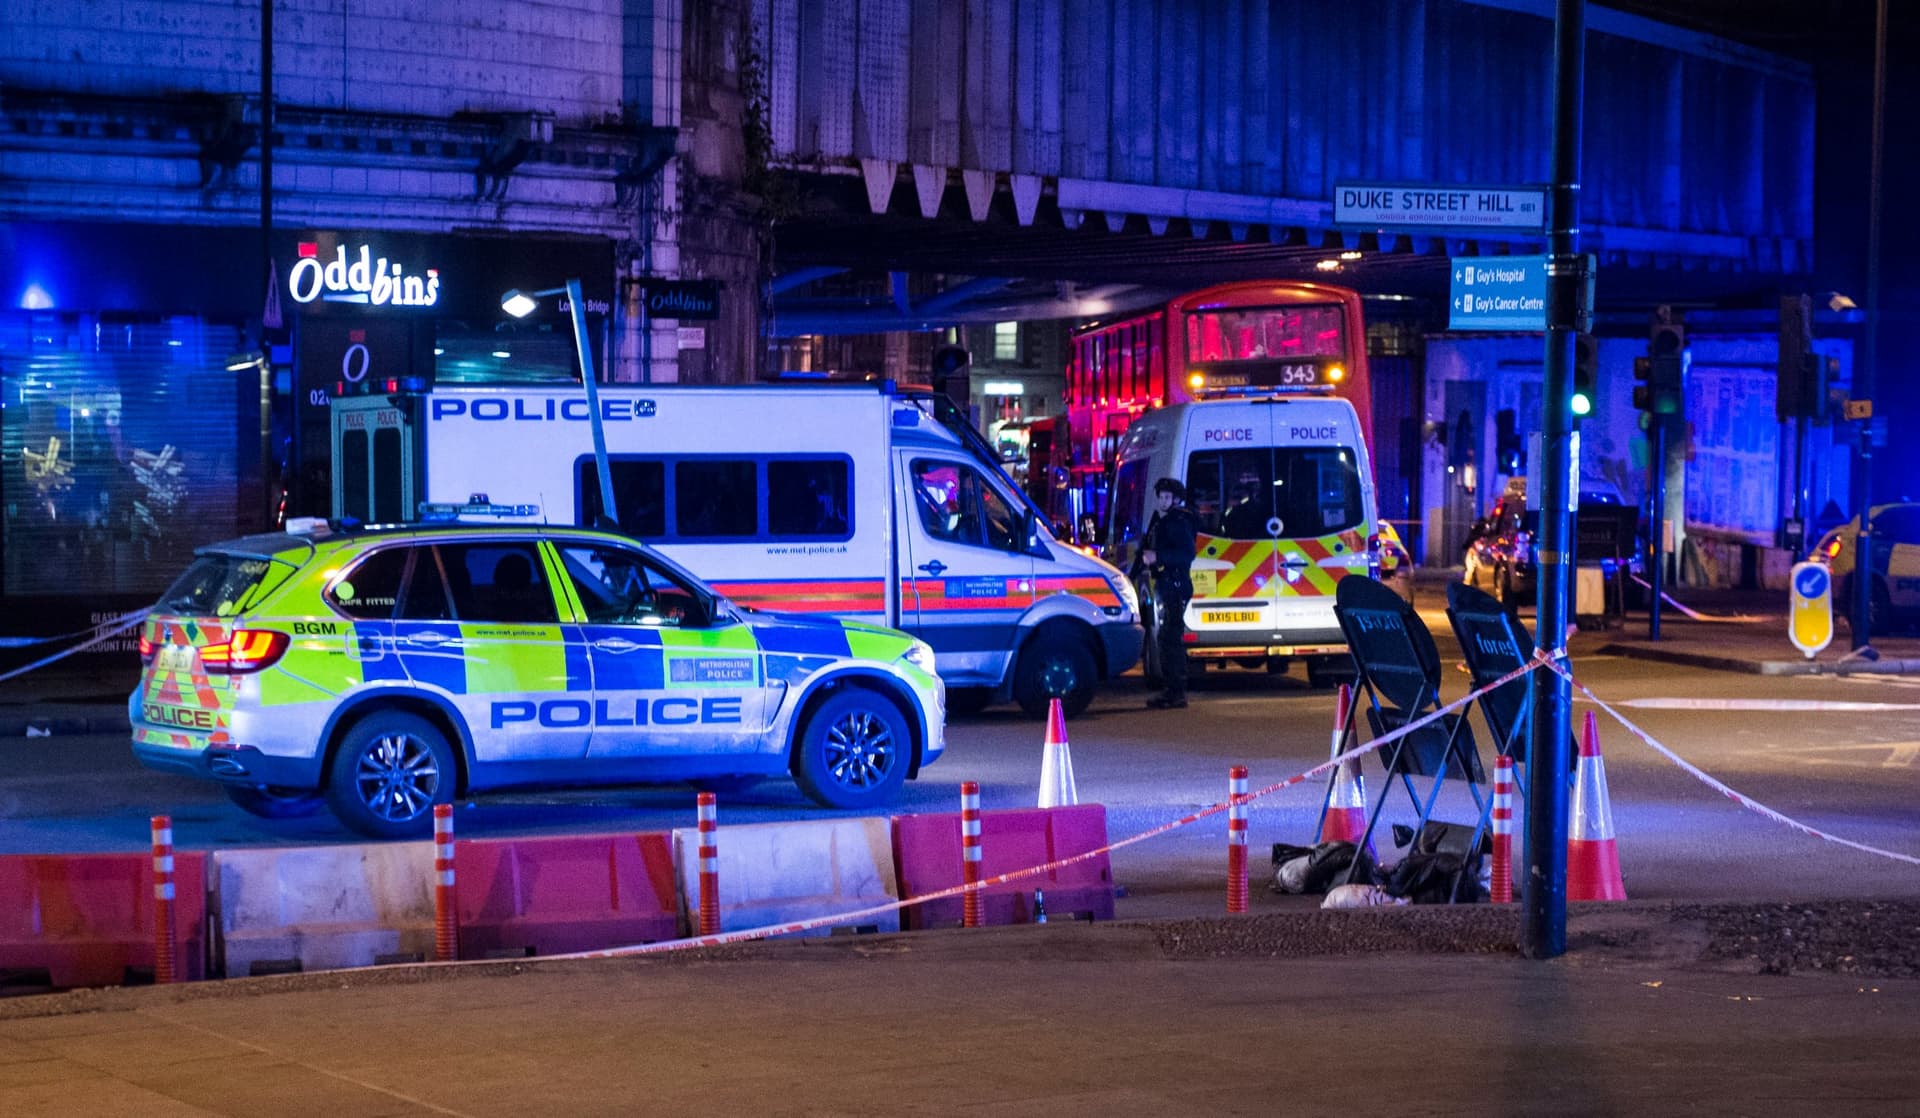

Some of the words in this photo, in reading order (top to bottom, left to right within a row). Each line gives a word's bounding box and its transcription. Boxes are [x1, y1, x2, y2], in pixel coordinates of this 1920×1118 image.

[1343, 190, 1393, 209] DUKE
[1402, 192, 1469, 211] STREET
[1478, 194, 1514, 213] HILL
[289, 244, 439, 306] Oddbins
[1476, 268, 1495, 286] Guy's
[1496, 268, 1525, 285] Hospital
[587, 300, 610, 315] Bridge
[651, 290, 713, 312] Oddbins
[1475, 296, 1494, 314] Guy's
[1494, 296, 1518, 310] Cancer
[1519, 296, 1544, 310] Centre
[1284, 365, 1315, 383] 343
[432, 399, 632, 421] POLICE
[1204, 428, 1253, 442] POLICE
[1290, 426, 1338, 440] POLICE
[766, 545, 848, 555] www.met.police.uk
[366, 597, 396, 606] FITTED
[1208, 611, 1231, 623] BX15
[1233, 611, 1255, 622] LBU
[294, 622, 337, 635] BGM
[699, 660, 750, 669] METROPOLITAN
[707, 670, 743, 679] POLICE
[143, 703, 213, 729] POLICE
[491, 697, 742, 728] POLICE
